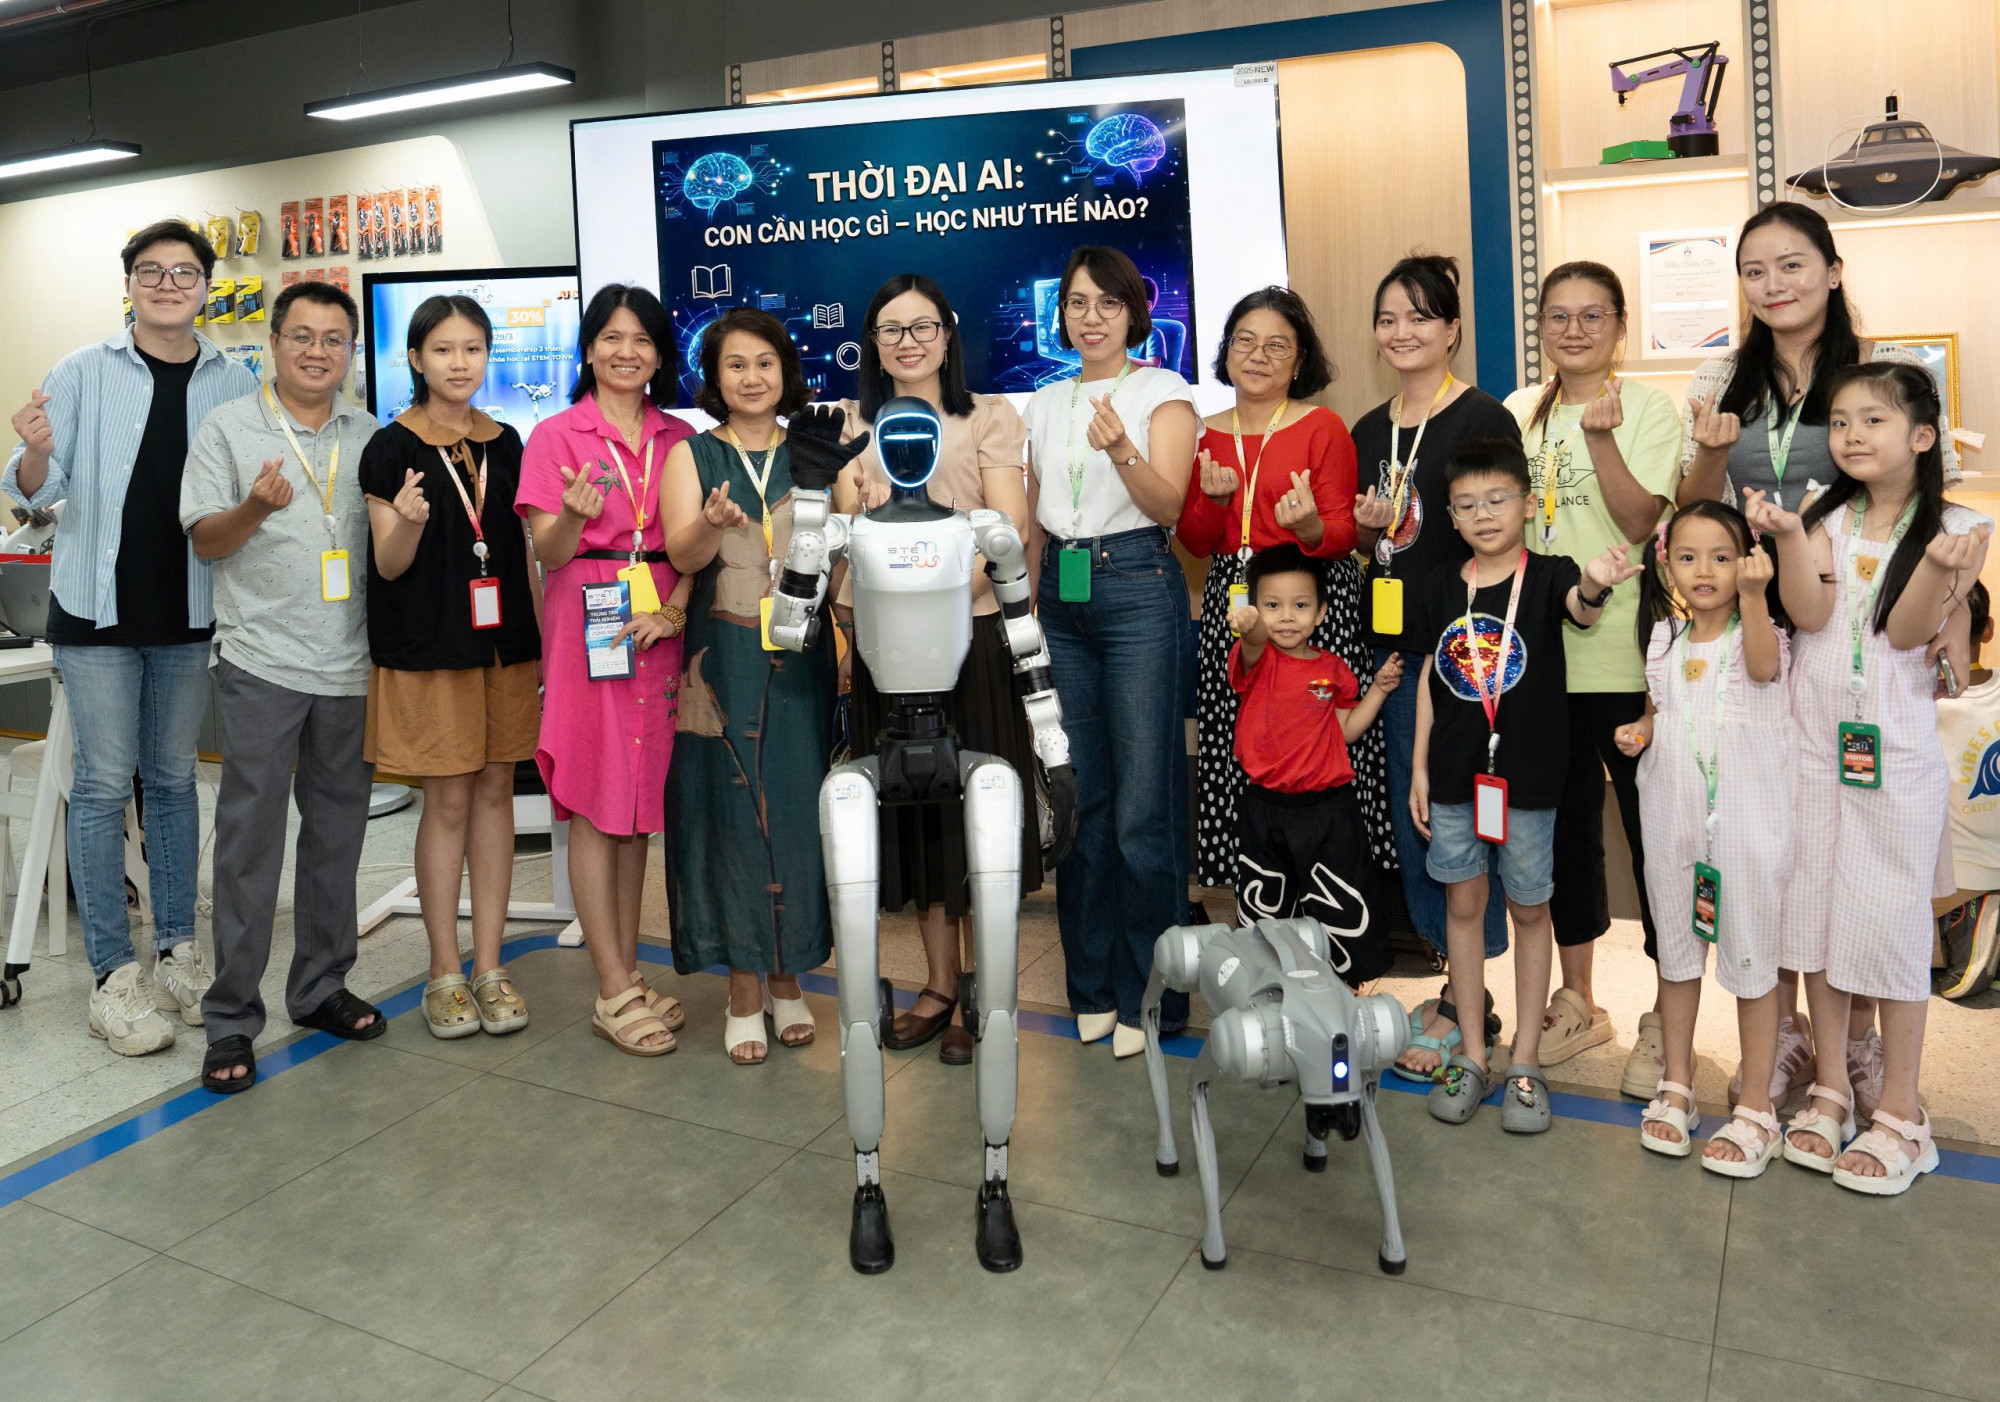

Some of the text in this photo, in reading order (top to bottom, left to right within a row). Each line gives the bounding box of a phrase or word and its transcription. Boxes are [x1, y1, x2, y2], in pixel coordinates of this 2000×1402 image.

[1254, 65, 1275, 74] NEW
[808, 158, 1024, 203] THỜI ĐẠI AI:
[704, 224, 752, 247] CON
[757, 214, 806, 243] CẦN
[811, 216, 861, 244] HỌC
[866, 209, 889, 236] GÌ
[915, 209, 967, 237] HỌC
[972, 203, 1027, 229] NHƯ
[1030, 193, 1079, 225] THẾ
[1084, 193, 1149, 222] NÀO?
[511, 310, 542, 324] 30%
[495, 346, 538, 355] Membership
[539, 345, 544, 353] 3
[532, 354, 550, 362] STEM
[551, 353, 574, 361] TOWN
[1537, 495, 1590, 508] BLANCE
[1845, 753, 1873, 763] VISITOR
[1958, 725, 1992, 785] VIBES
[1961, 799, 1997, 815] CATCH
